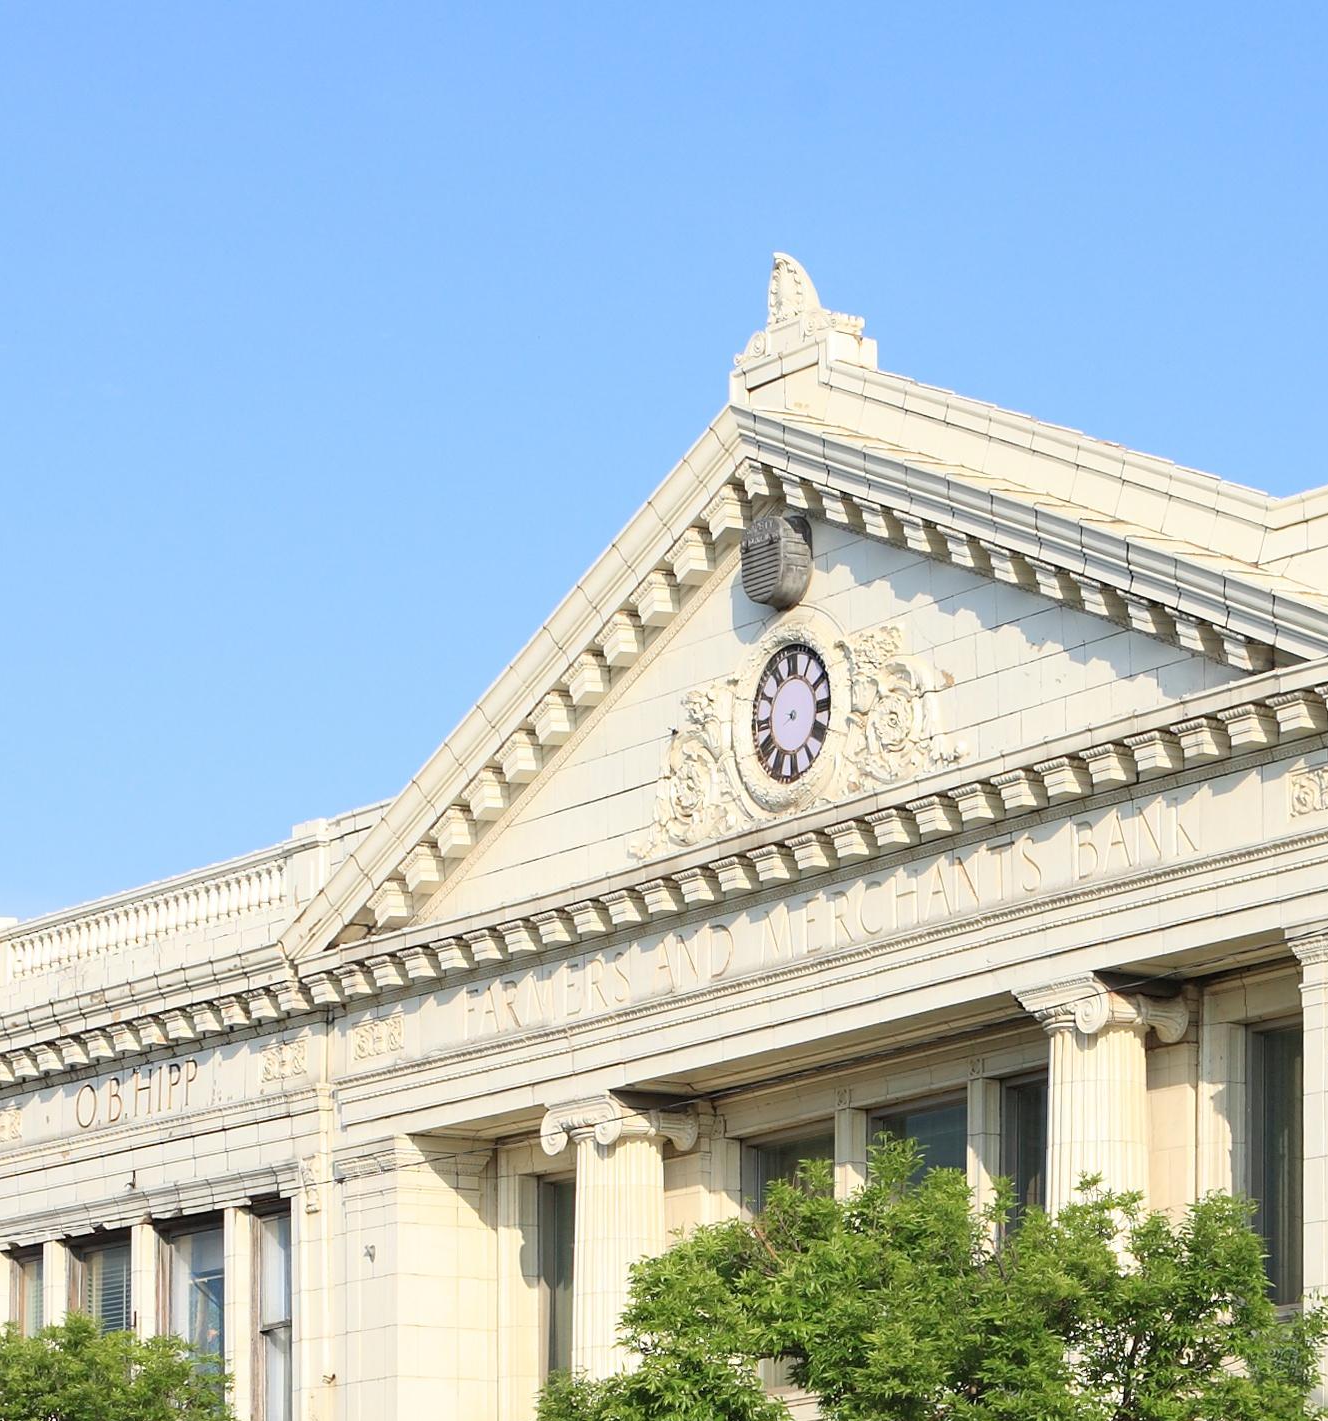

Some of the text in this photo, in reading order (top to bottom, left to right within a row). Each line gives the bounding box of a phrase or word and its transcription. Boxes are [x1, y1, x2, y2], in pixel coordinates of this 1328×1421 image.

[461, 797, 1200, 1040] FARMERS AND MERCHANTS BANK
